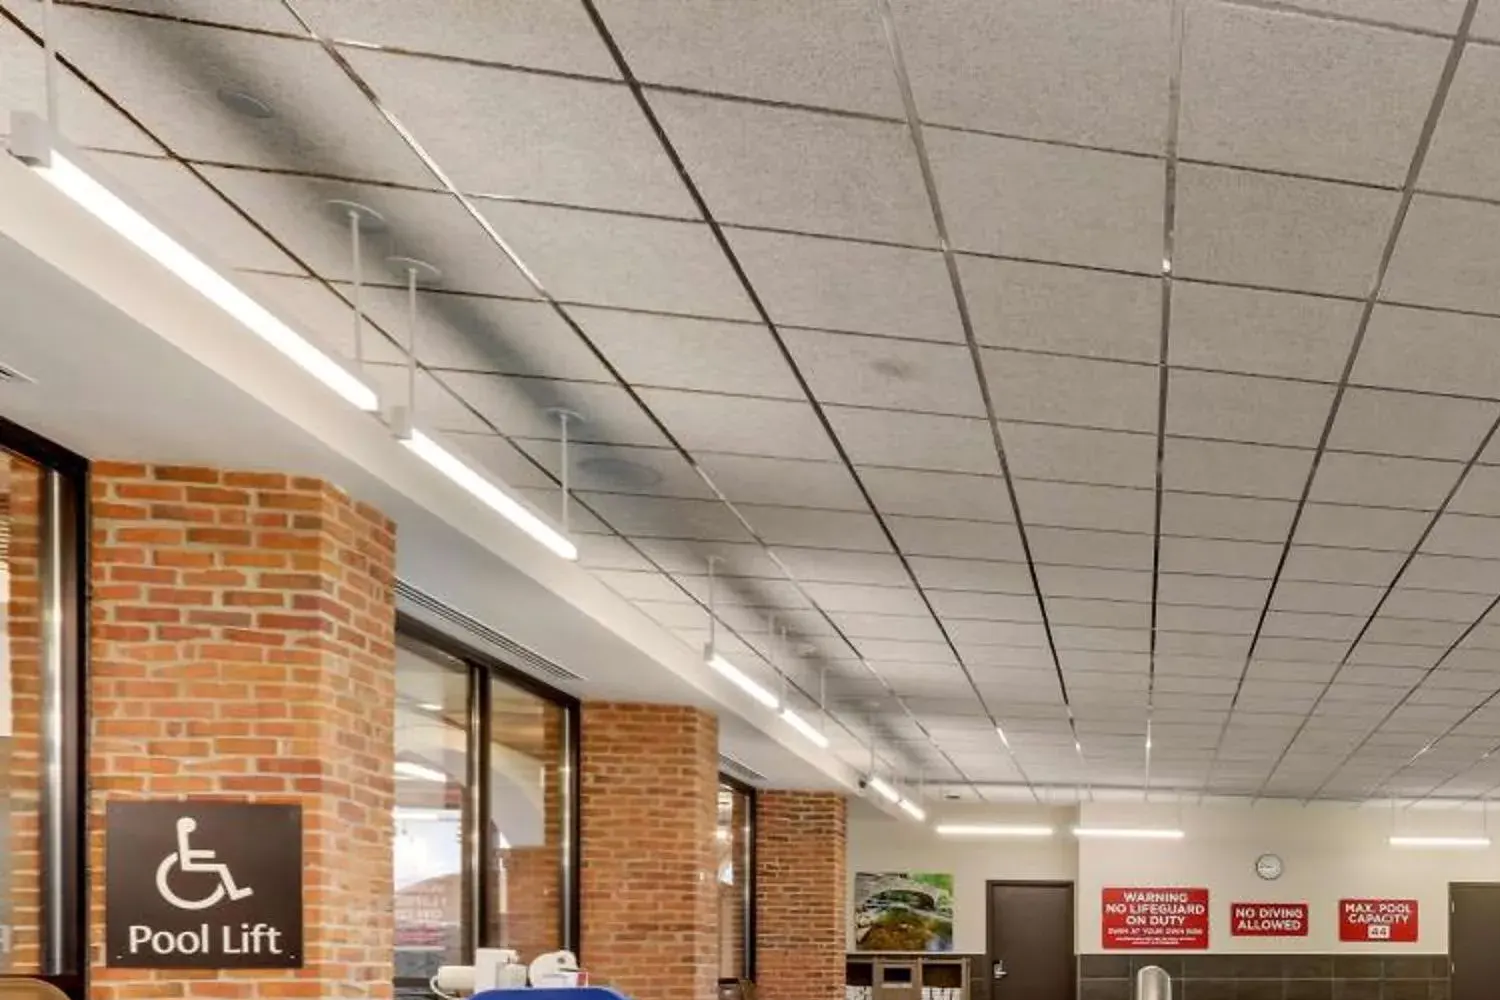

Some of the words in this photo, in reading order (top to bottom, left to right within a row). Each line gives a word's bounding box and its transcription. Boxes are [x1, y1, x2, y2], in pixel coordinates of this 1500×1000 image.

[1123, 891, 1189, 903] WARNING
[1106, 903, 1127, 914] NO
[1129, 903, 1205, 915] LIFEGUARD
[1235, 908, 1255, 919] NO
[1259, 907, 1304, 919] DIVING
[1379, 903, 1411, 914] POOL
[1125, 915, 1147, 926] ON
[1149, 915, 1185, 926] DUTY
[1348, 914, 1409, 924] CAPACITY
[1237, 920, 1302, 931] ALLOWED
[129, 923, 209, 955] Pool
[222, 923, 283, 954] Lift
